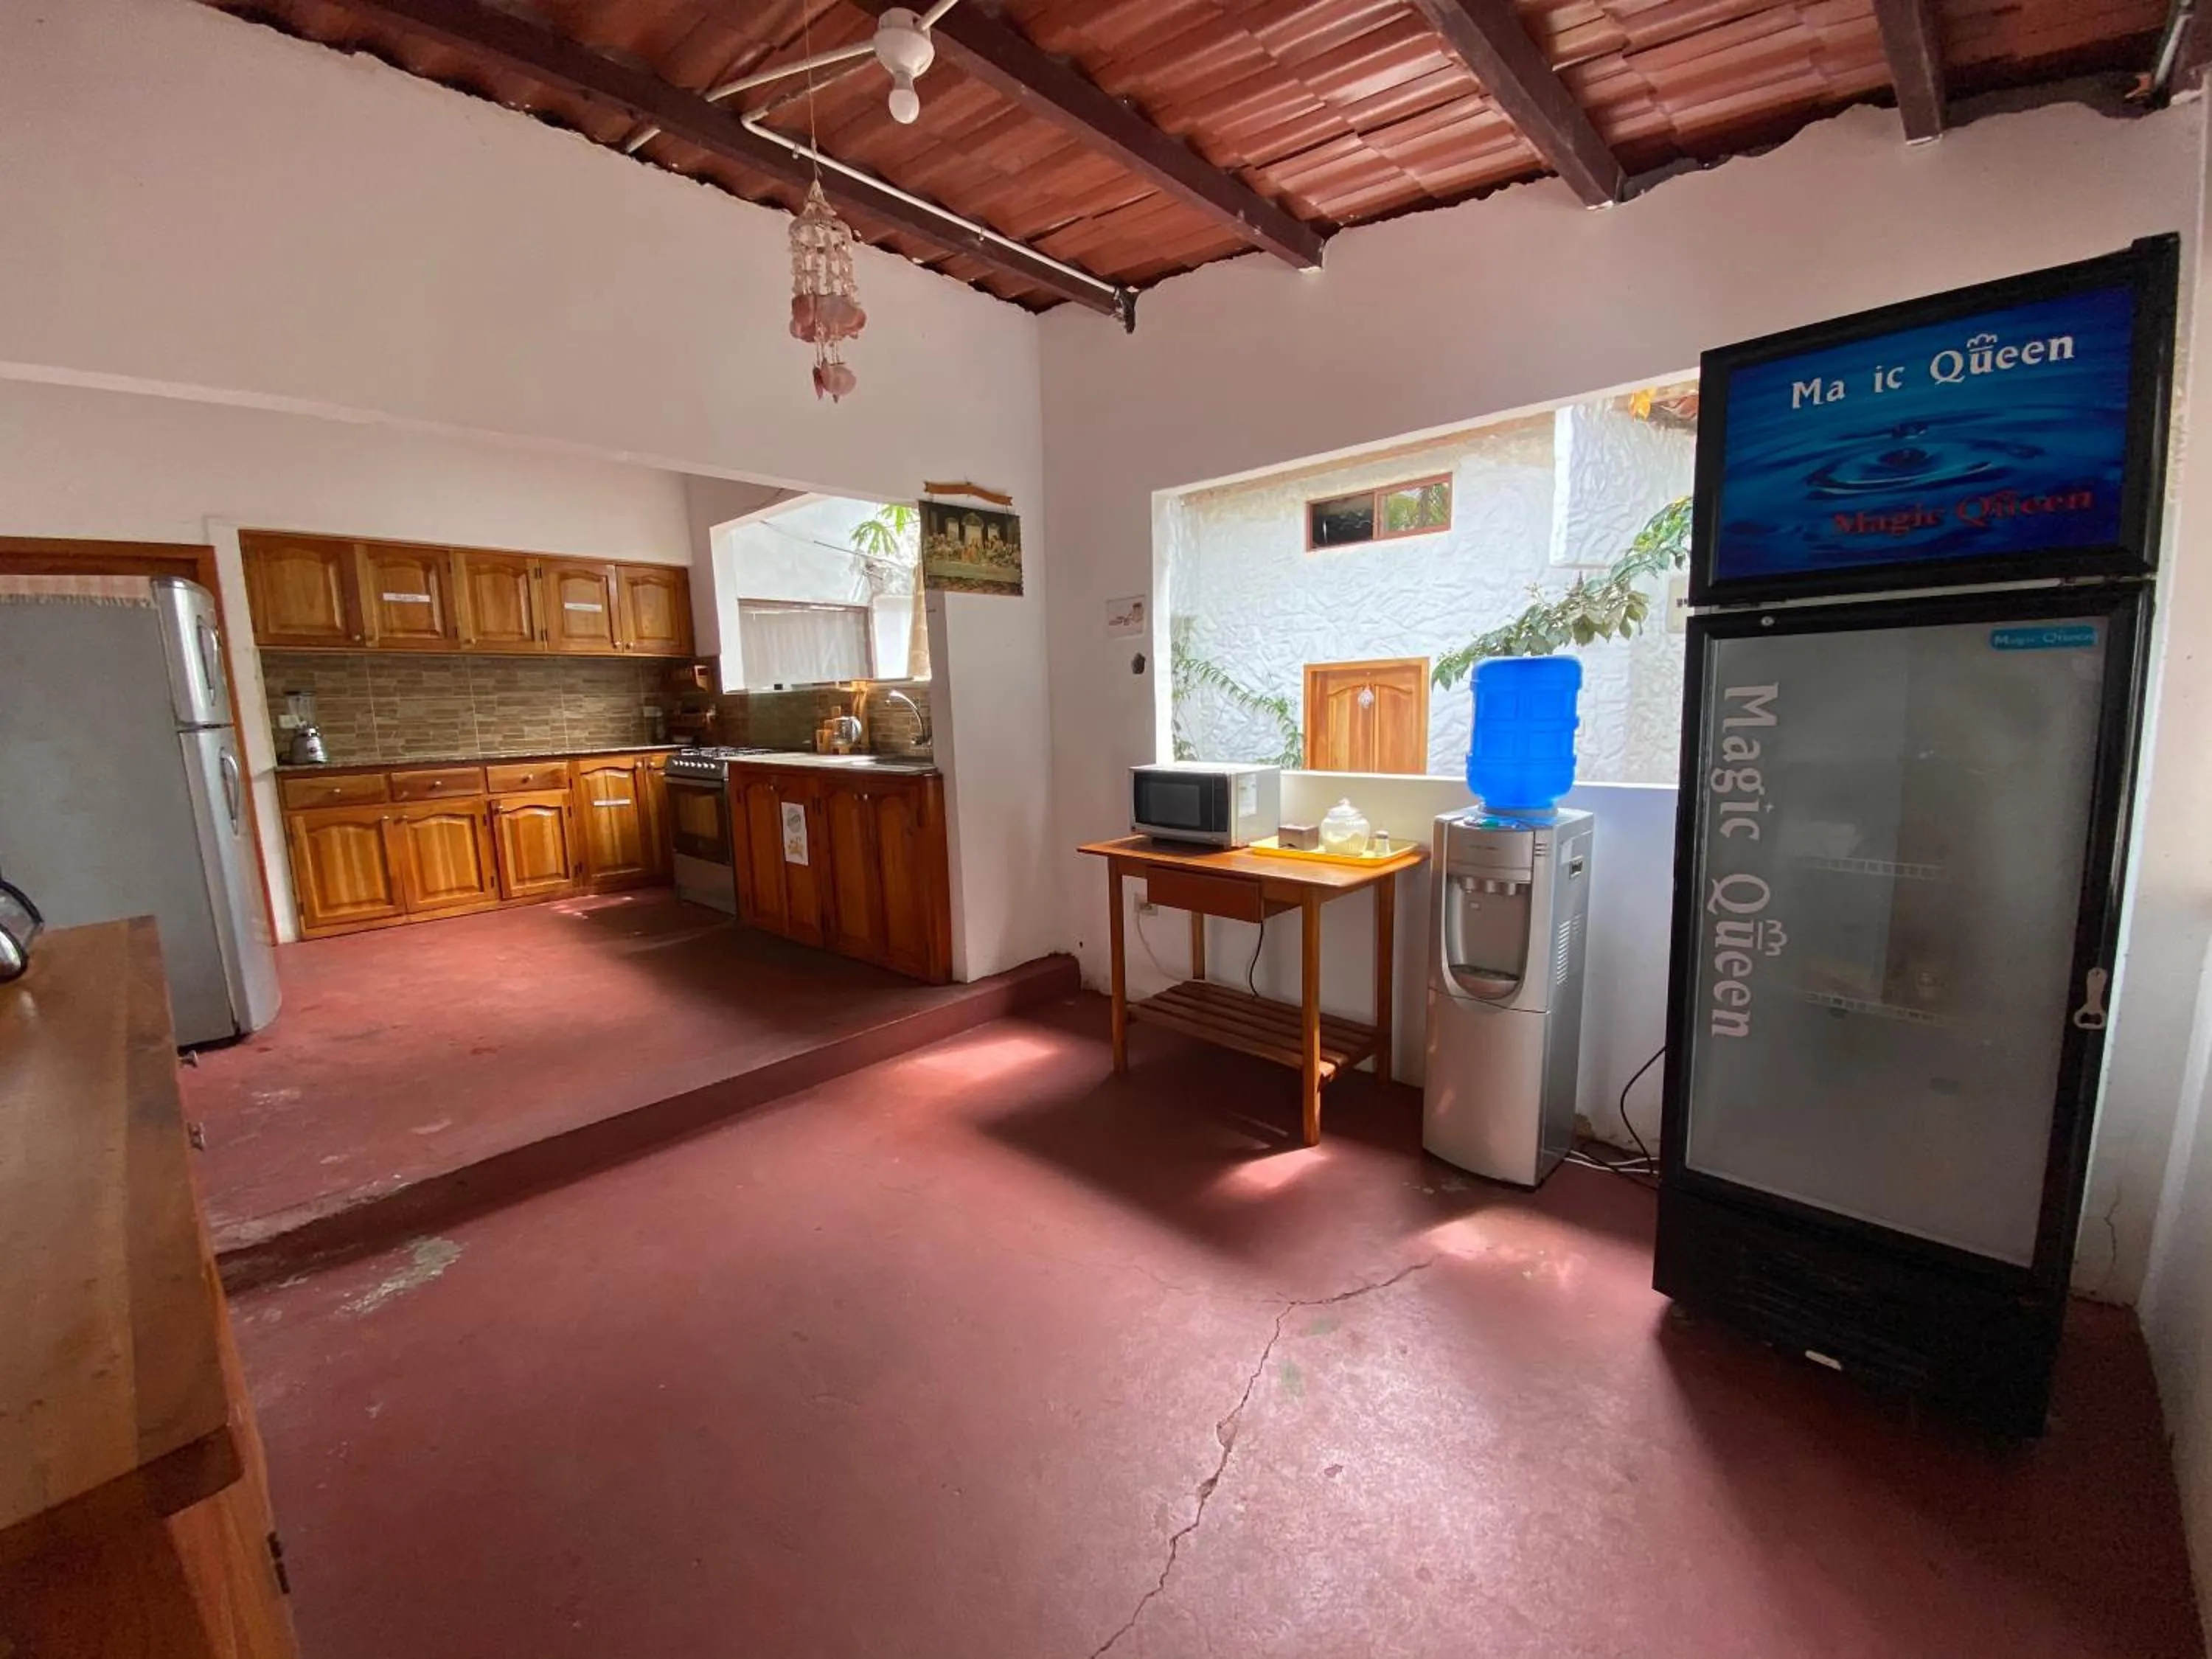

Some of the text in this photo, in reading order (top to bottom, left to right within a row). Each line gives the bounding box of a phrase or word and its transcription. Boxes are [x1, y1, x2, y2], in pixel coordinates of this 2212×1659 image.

[1929, 334, 2075, 386] Queen
[1835, 491, 2093, 538] Magic Queen
[1707, 681, 1779, 1038] Magic Queen
